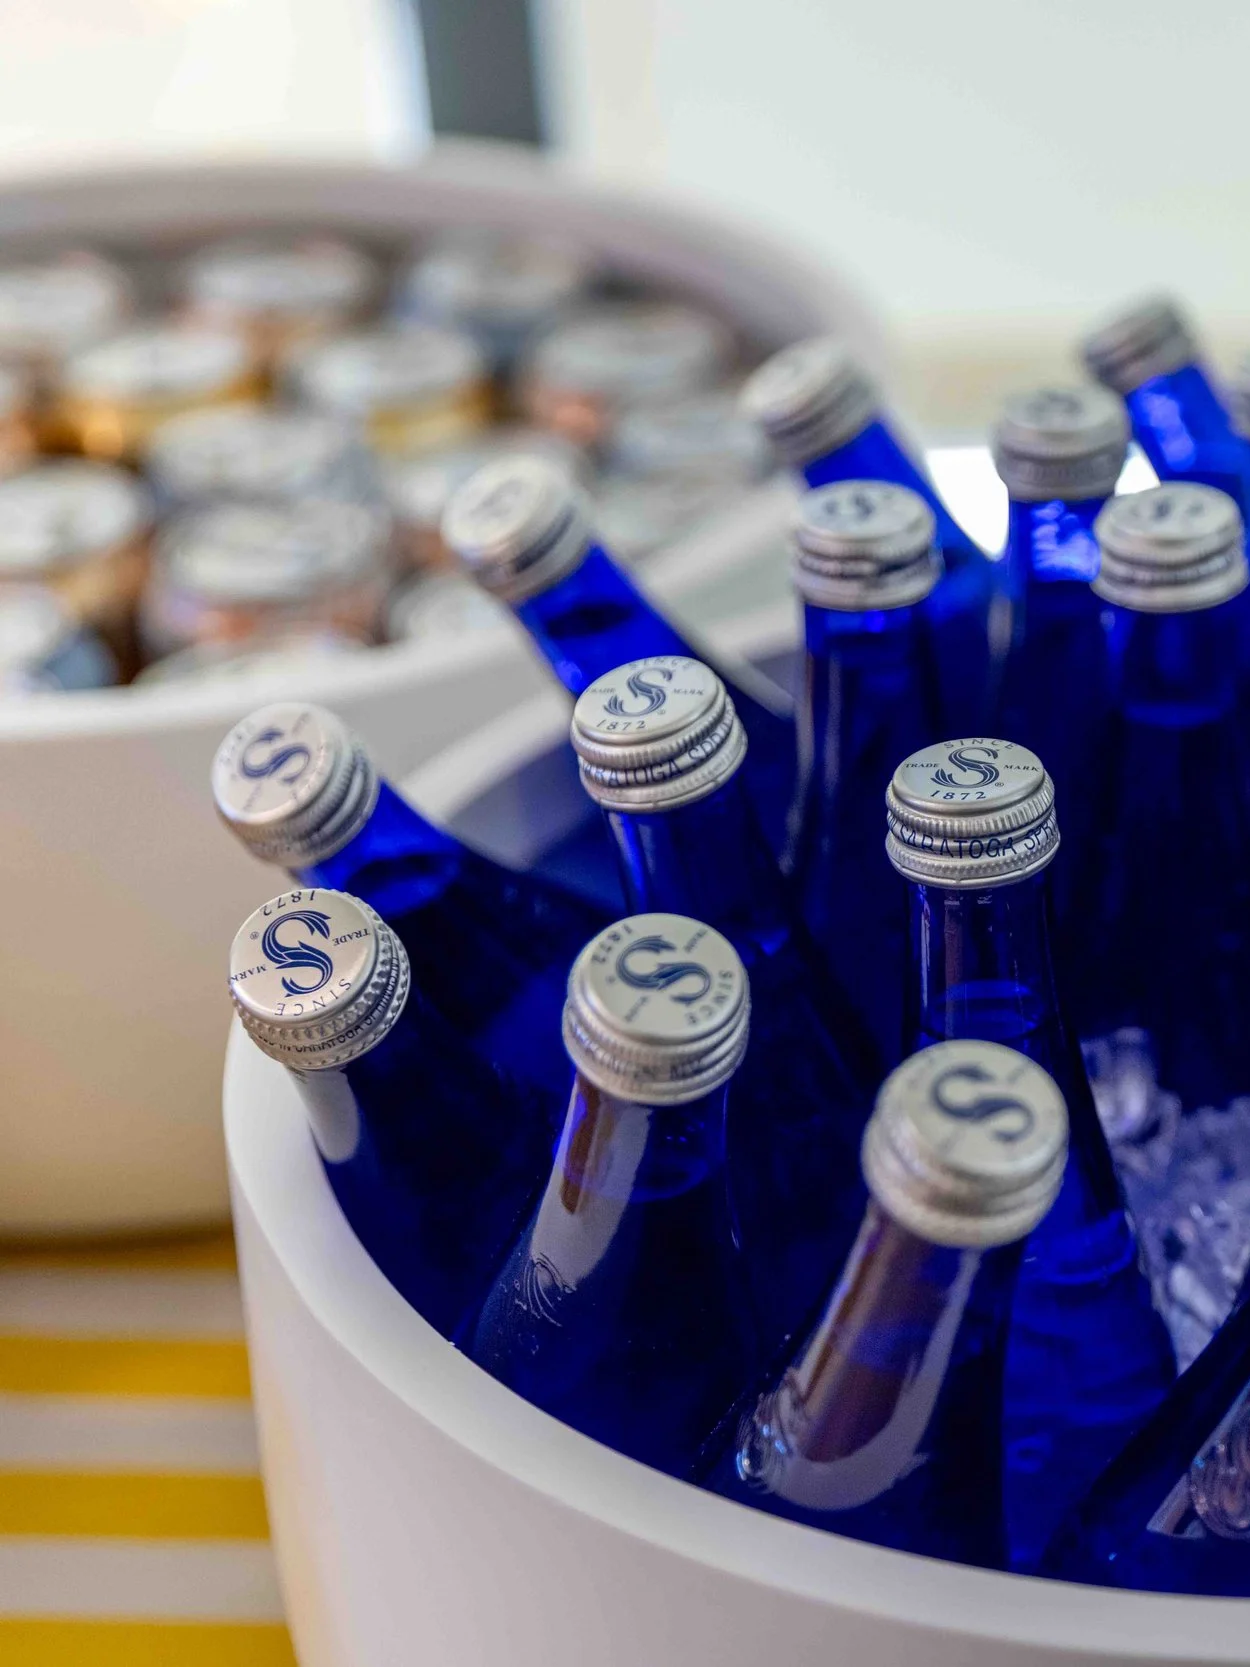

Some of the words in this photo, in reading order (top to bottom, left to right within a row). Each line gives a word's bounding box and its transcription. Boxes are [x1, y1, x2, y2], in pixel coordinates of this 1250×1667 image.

[597, 719, 647, 732] 1872
[943, 738, 1017, 751] SINCE
[1003, 764, 1041, 772] MARK
[930, 789, 987, 801] 1872
[900, 823, 1017, 860] SARATOGA
[260, 889, 317, 917] 1872
[332, 928, 371, 947] TRADE
[274, 978, 352, 1017] SINCE
